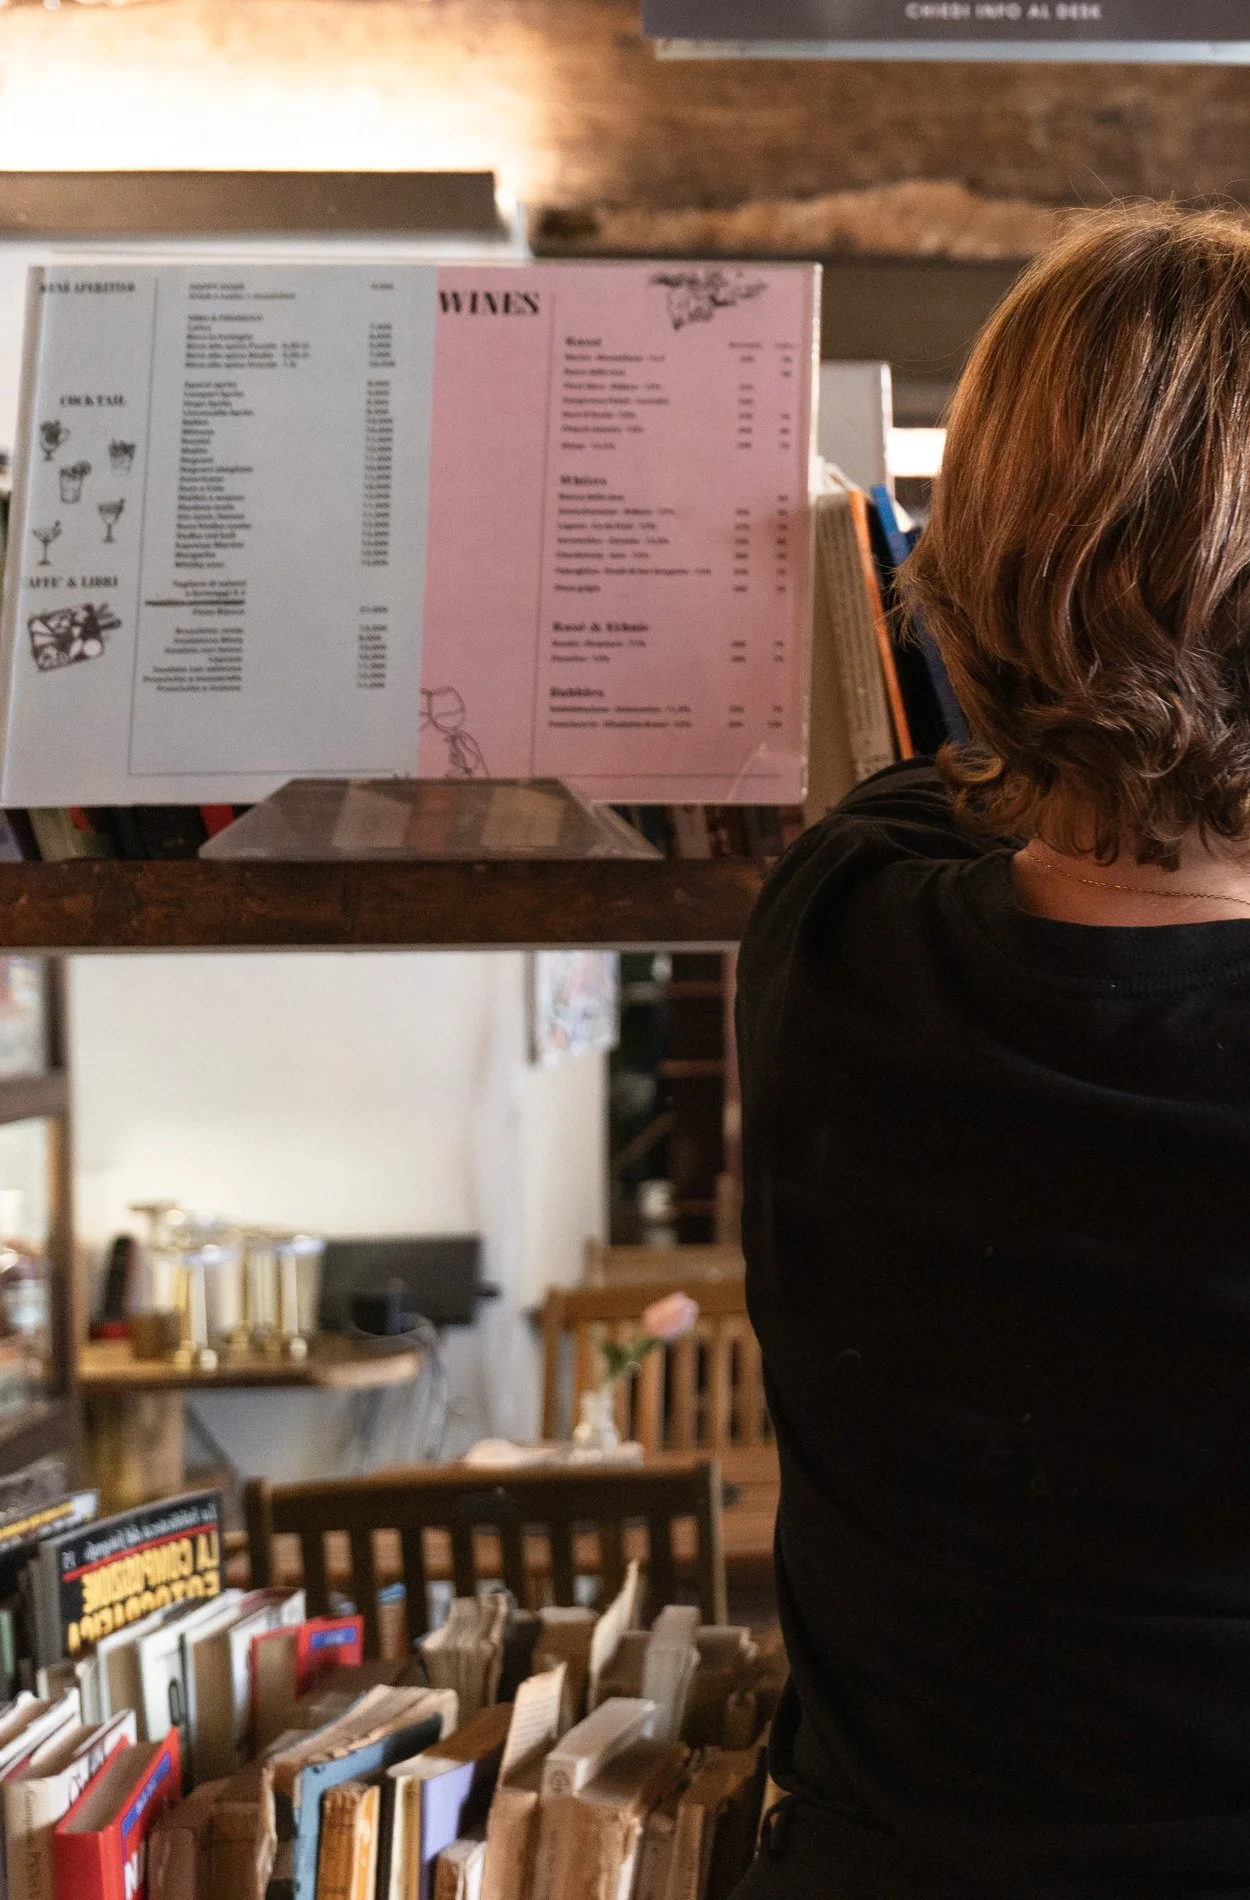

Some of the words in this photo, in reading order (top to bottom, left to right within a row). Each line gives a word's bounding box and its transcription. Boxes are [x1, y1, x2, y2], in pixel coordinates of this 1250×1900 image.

[905, 2, 970, 20] CHIEDI
[974, 2, 1023, 20] INFO
[1027, 3, 1051, 20] AL
[1055, 3, 1103, 20] DESK
[438, 289, 541, 316] WINES
[59, 394, 127, 408] COCKTAIL
[81, 576, 119, 588] LIBRI
